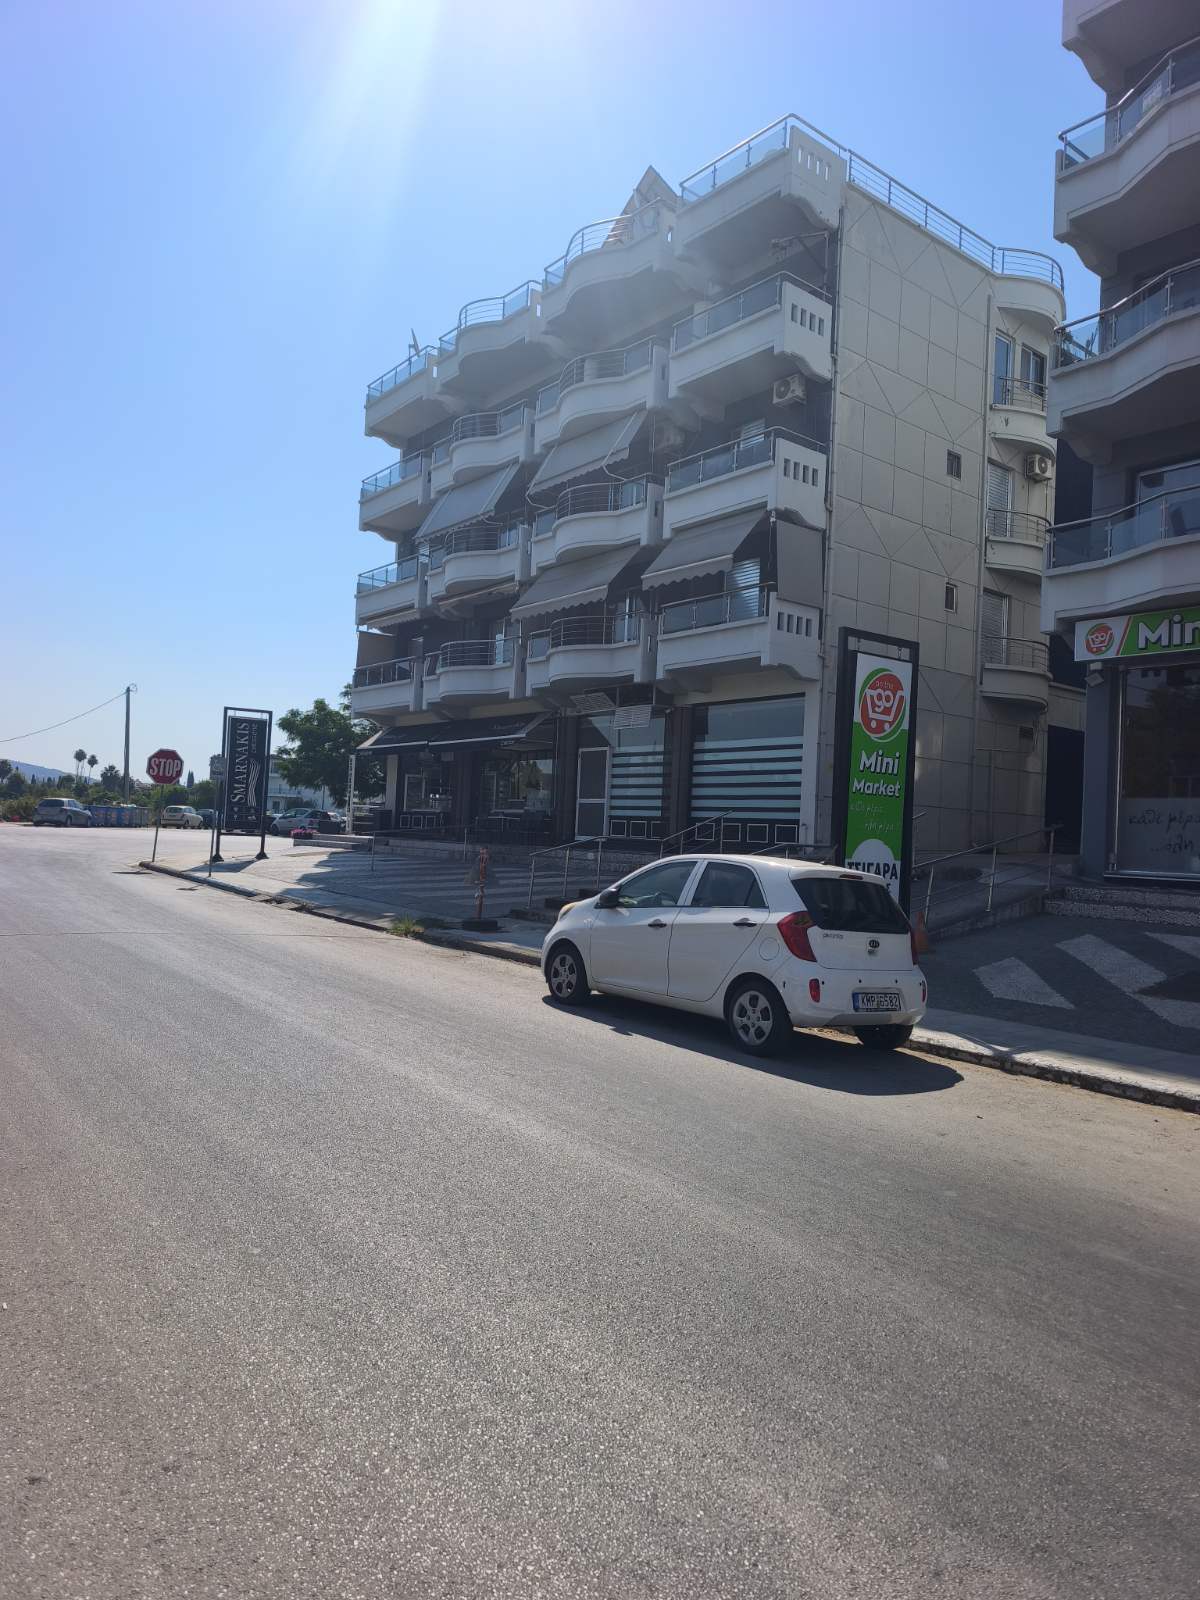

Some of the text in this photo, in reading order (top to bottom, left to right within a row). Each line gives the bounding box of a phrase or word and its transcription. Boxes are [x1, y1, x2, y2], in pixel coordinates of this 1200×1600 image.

[149, 757, 181, 777] STOP
[230, 722, 250, 803] SMARNAKIS
[859, 749, 900, 775] Mini
[852, 777, 901, 797] Market
